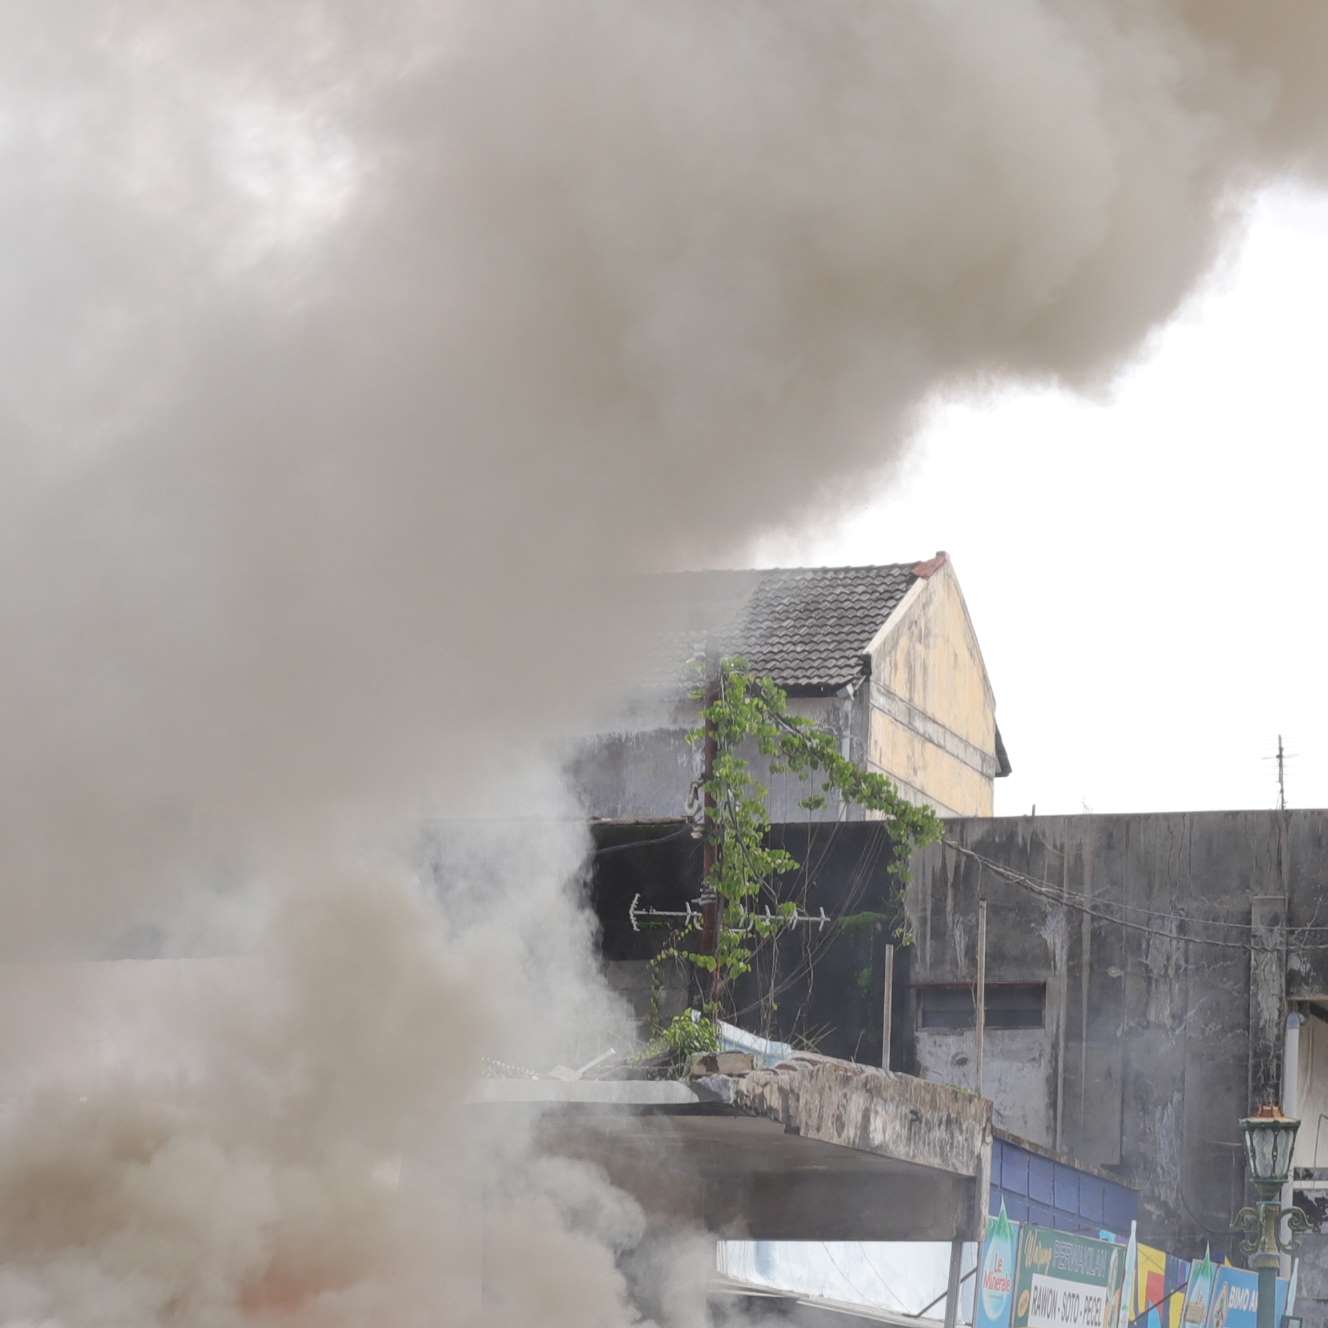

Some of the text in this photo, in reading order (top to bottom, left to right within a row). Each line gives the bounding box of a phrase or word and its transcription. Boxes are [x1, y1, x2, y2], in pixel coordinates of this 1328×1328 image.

[1031, 1285, 1058, 1321] RAWON
[1062, 1291, 1079, 1325] SOTO
[1229, 1285, 1249, 1311] BIMO
